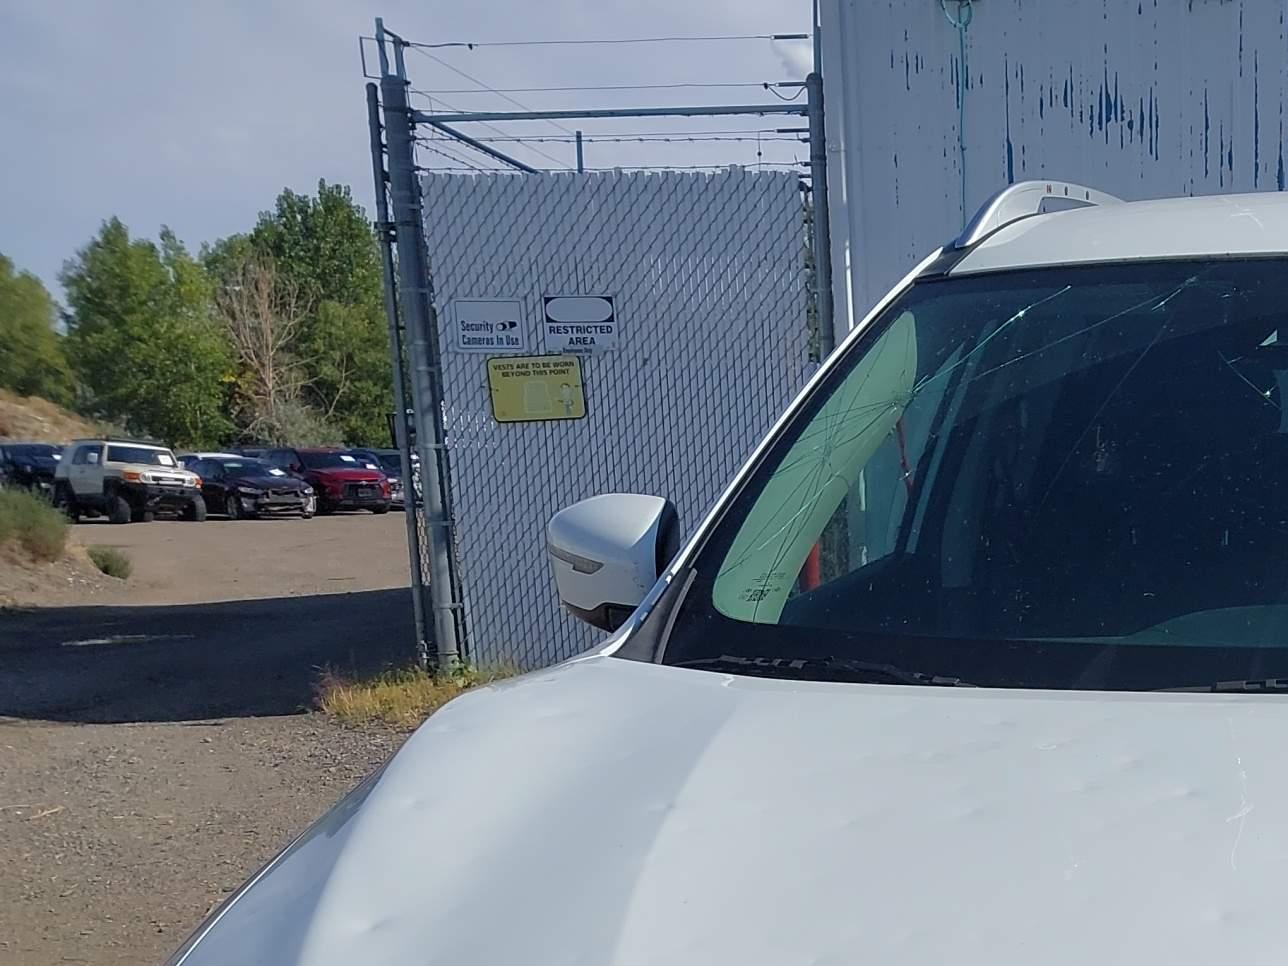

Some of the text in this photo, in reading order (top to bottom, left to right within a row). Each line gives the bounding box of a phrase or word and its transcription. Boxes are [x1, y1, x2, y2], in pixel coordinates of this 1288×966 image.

[461, 320, 494, 334] Security
[549, 325, 613, 335] RESTRICTED
[462, 334, 520, 346] Cameras In Use
[568, 337, 596, 346] AREA
[493, 363, 514, 371] VESTS
[516, 362, 529, 370] ARE
[542, 361, 552, 369] BE
[502, 370, 531, 378] BEYOND
